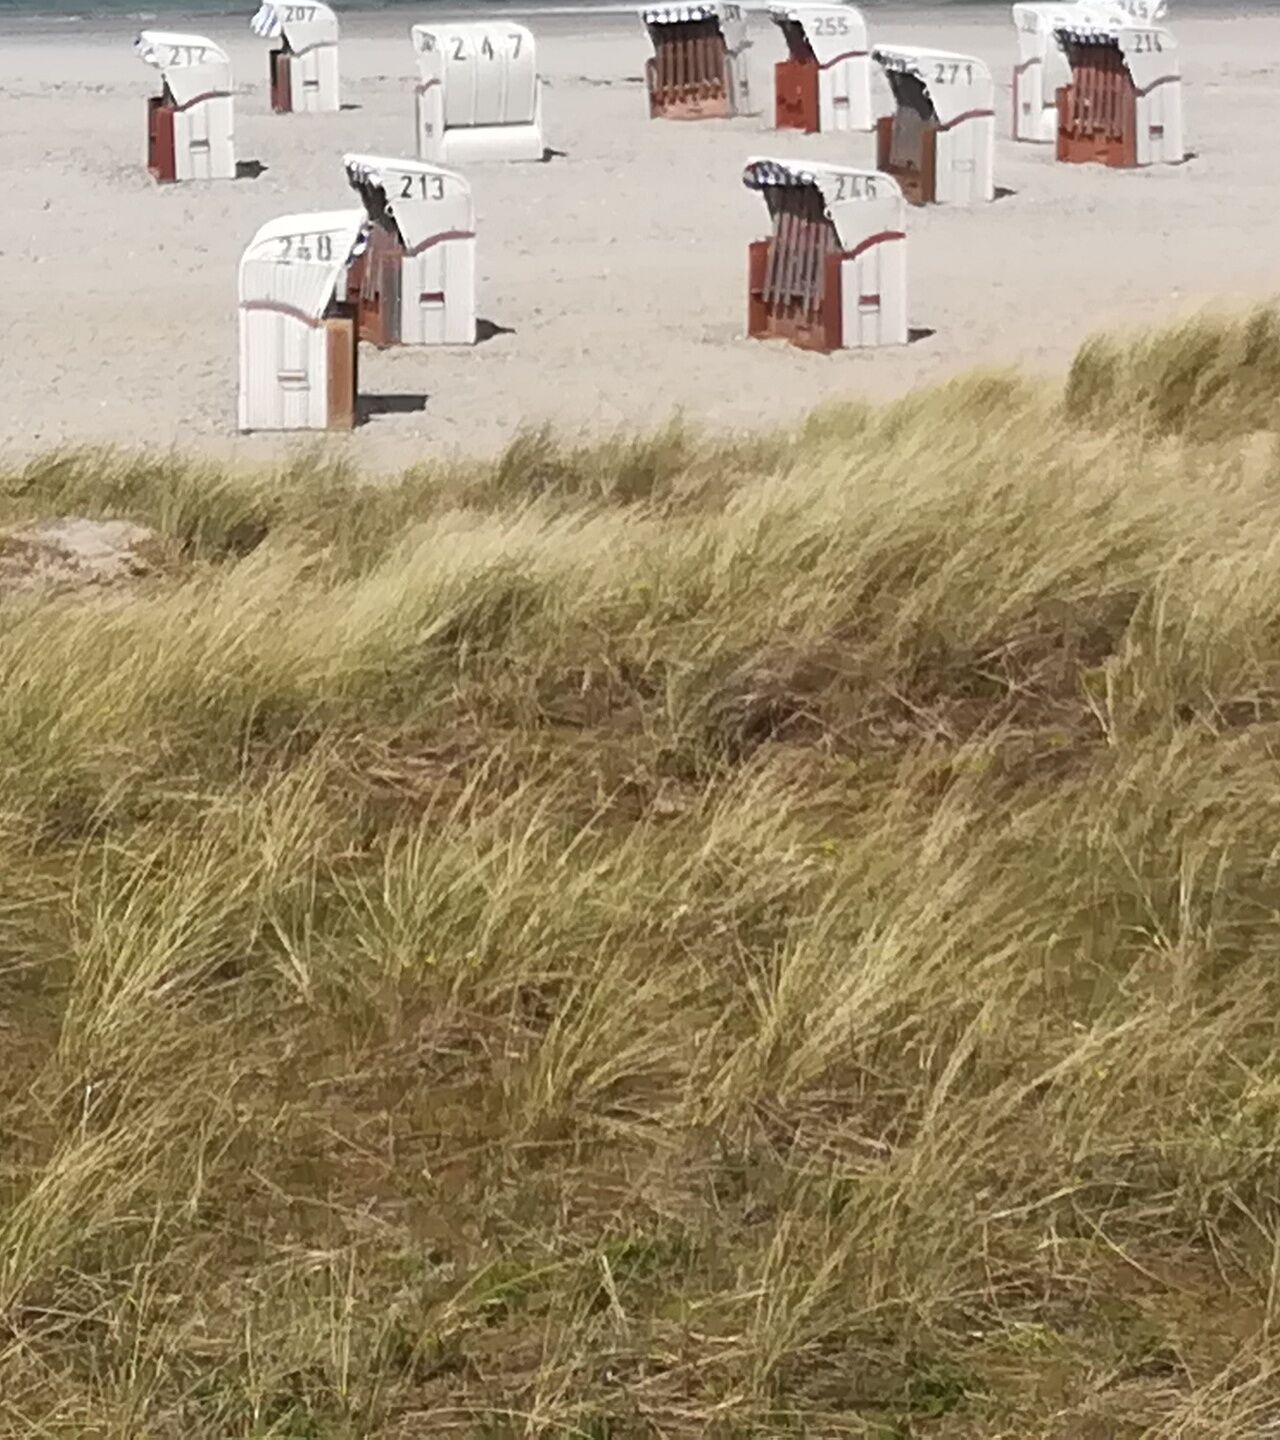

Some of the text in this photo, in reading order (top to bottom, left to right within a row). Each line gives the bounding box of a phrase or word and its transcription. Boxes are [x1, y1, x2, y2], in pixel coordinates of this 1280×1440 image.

[284, 6, 316, 22] 207
[813, 17, 850, 36] 255
[933, 62, 973, 86] 271
[399, 175, 445, 200] 213
